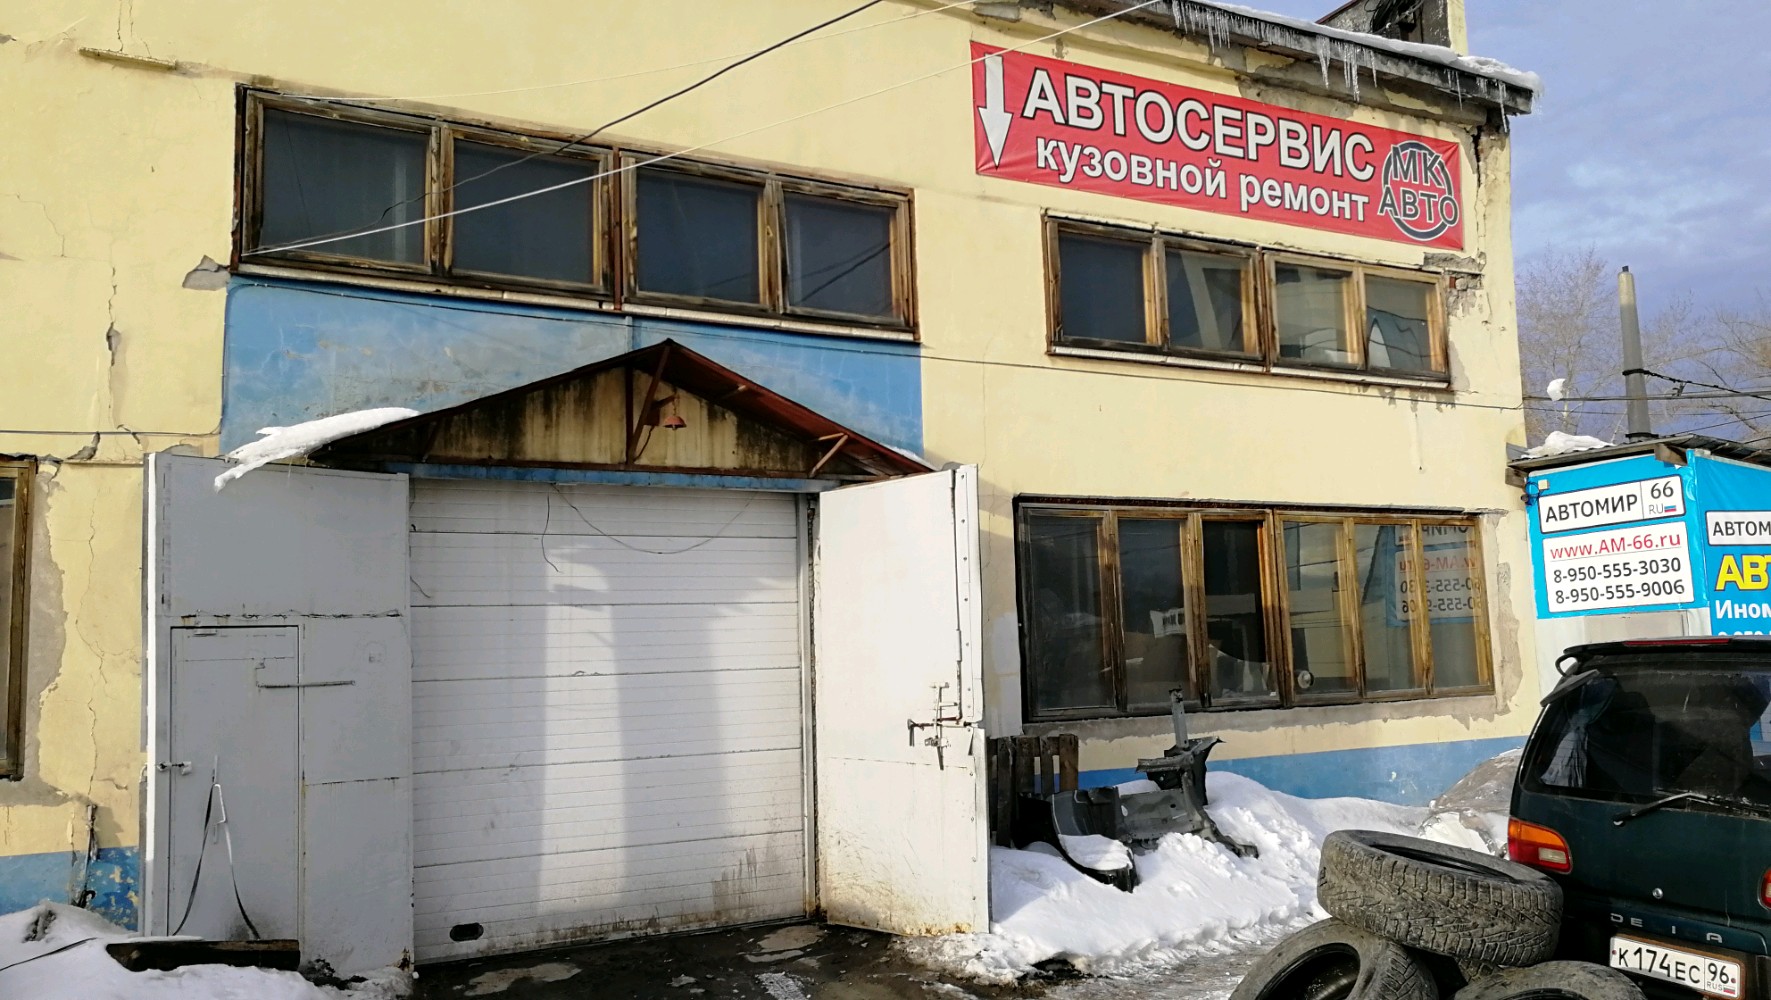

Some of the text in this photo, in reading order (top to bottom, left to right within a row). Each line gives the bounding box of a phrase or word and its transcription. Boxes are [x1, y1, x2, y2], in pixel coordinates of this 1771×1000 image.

[1020, 67, 1376, 182] АВТОСЕРВИС
[1036, 136, 1369, 222] кузовной ремонт
[1391, 144, 1445, 188] МК
[1377, 185, 1459, 226] АВТО
[1545, 481, 1674, 523] АВТОМИР 66
[1648, 503, 1664, 515] RU
[1550, 533, 1681, 559] www.AM-66.ru
[1553, 557, 1681, 583] 8-950-555-3030
[1555, 579, 1685, 604] 8-950-555-9006
[1618, 947, 1729, 984] К174ЕС 96
[1707, 981, 1723, 991] RUS
